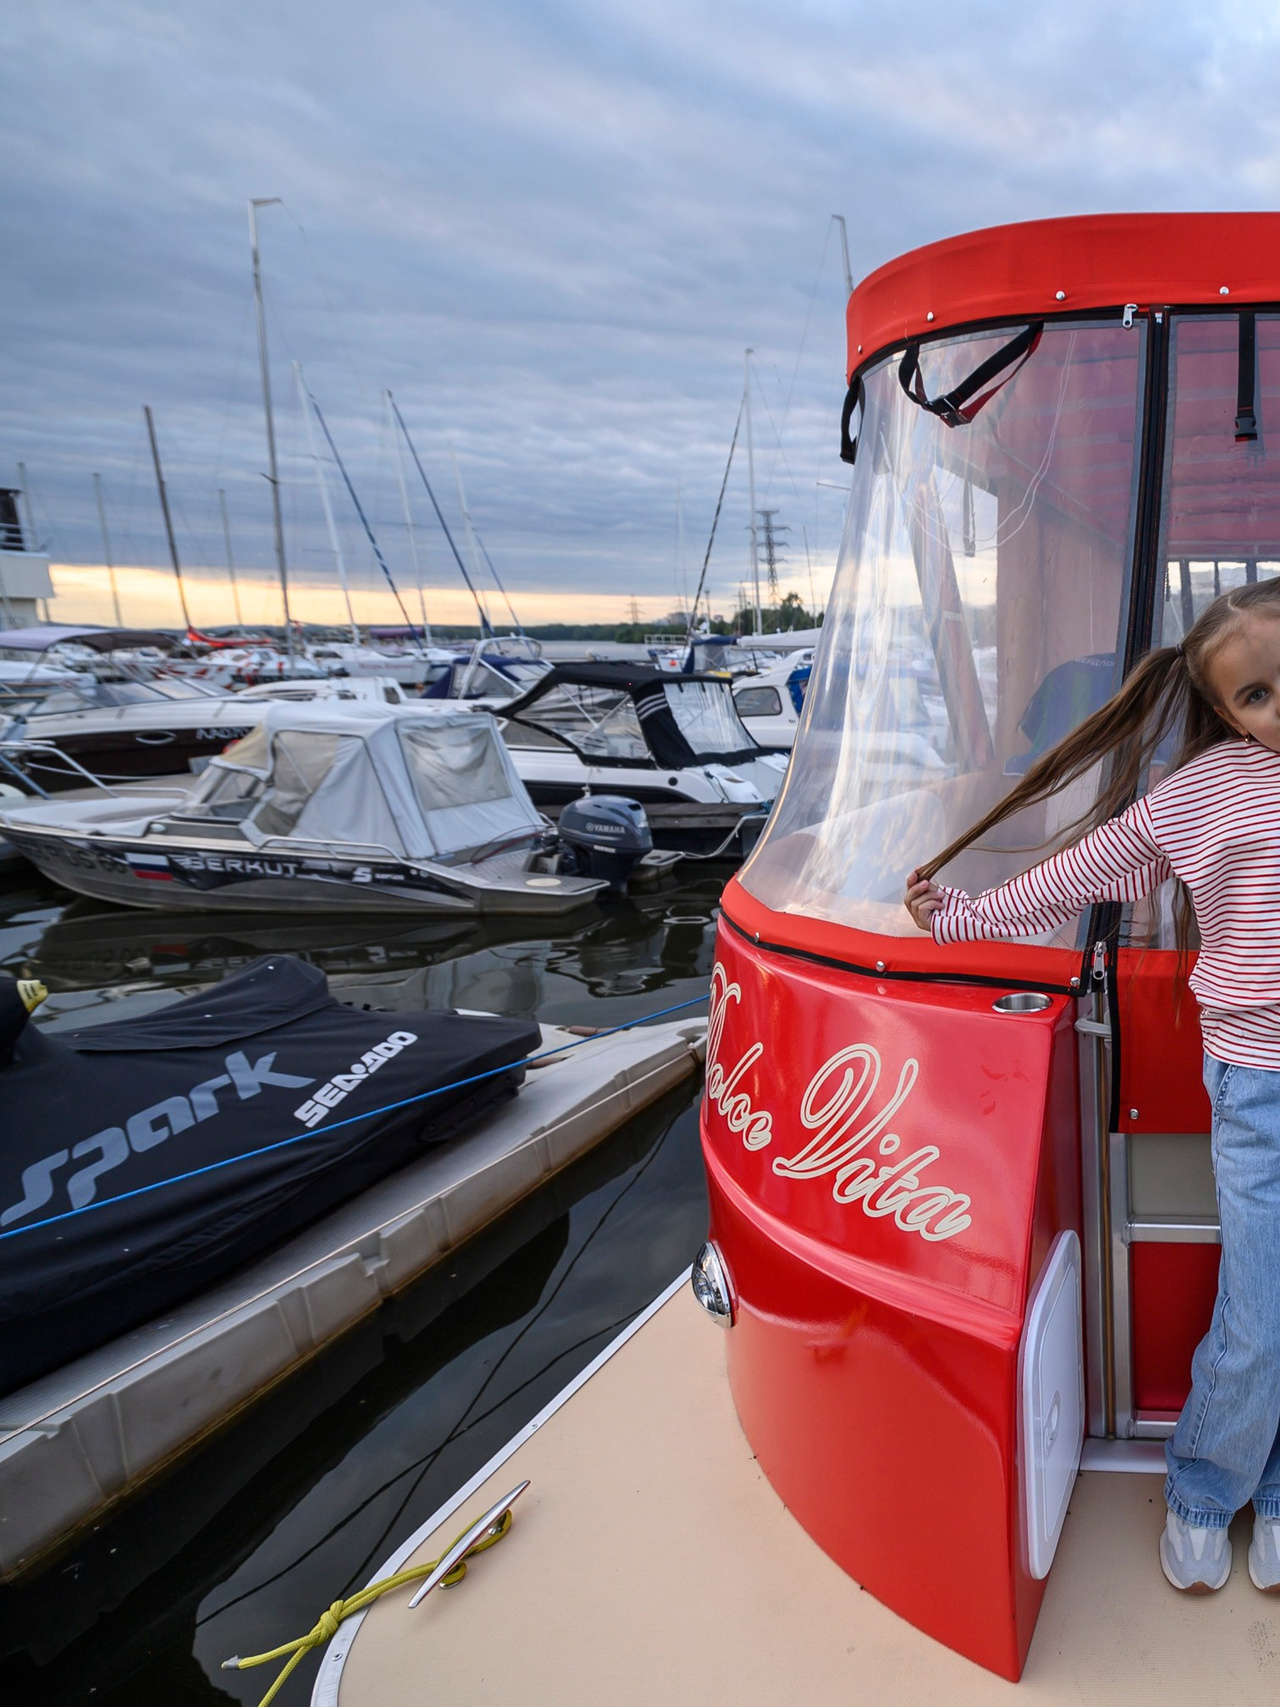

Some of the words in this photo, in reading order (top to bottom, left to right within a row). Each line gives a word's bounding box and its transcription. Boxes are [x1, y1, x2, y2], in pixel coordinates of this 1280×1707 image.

[593, 824, 625, 834] YAMAHA
[187, 856, 299, 877] BERKUT
[772, 1043, 972, 1242] Vita
